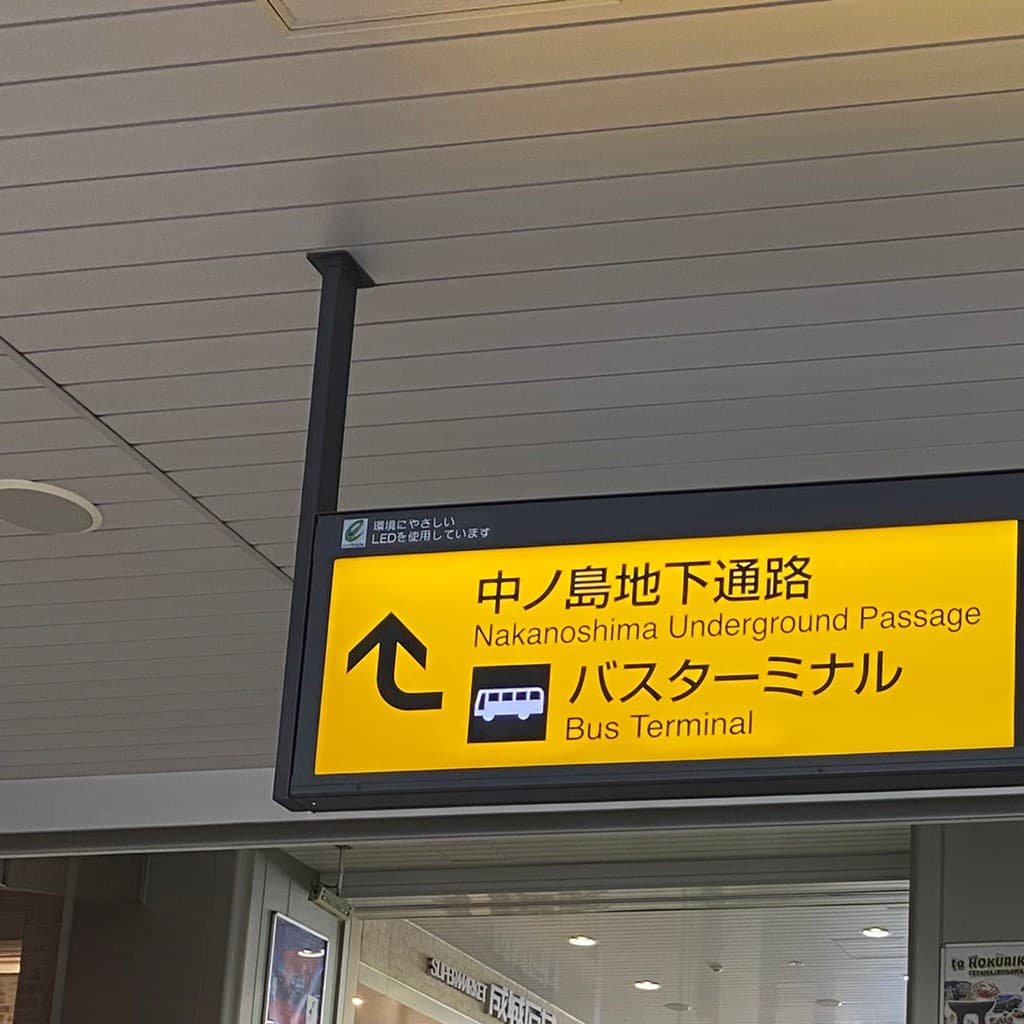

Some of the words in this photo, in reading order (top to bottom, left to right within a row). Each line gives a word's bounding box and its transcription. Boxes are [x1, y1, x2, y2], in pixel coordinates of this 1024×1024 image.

[371, 527, 491, 545] LEDを使用しています
[373, 516, 456, 531] 環境にやさしい
[477, 555, 813, 614] 中ノ島地下通路
[474, 618, 658, 648] Nakanoshima
[669, 609, 849, 642] Underground
[860, 605, 982, 632] Passage
[567, 649, 904, 706] バスターミナル
[565, 716, 620, 742] Bus
[631, 711, 754, 740] Terminal
[430, 957, 488, 1004] SUPERMARKET
